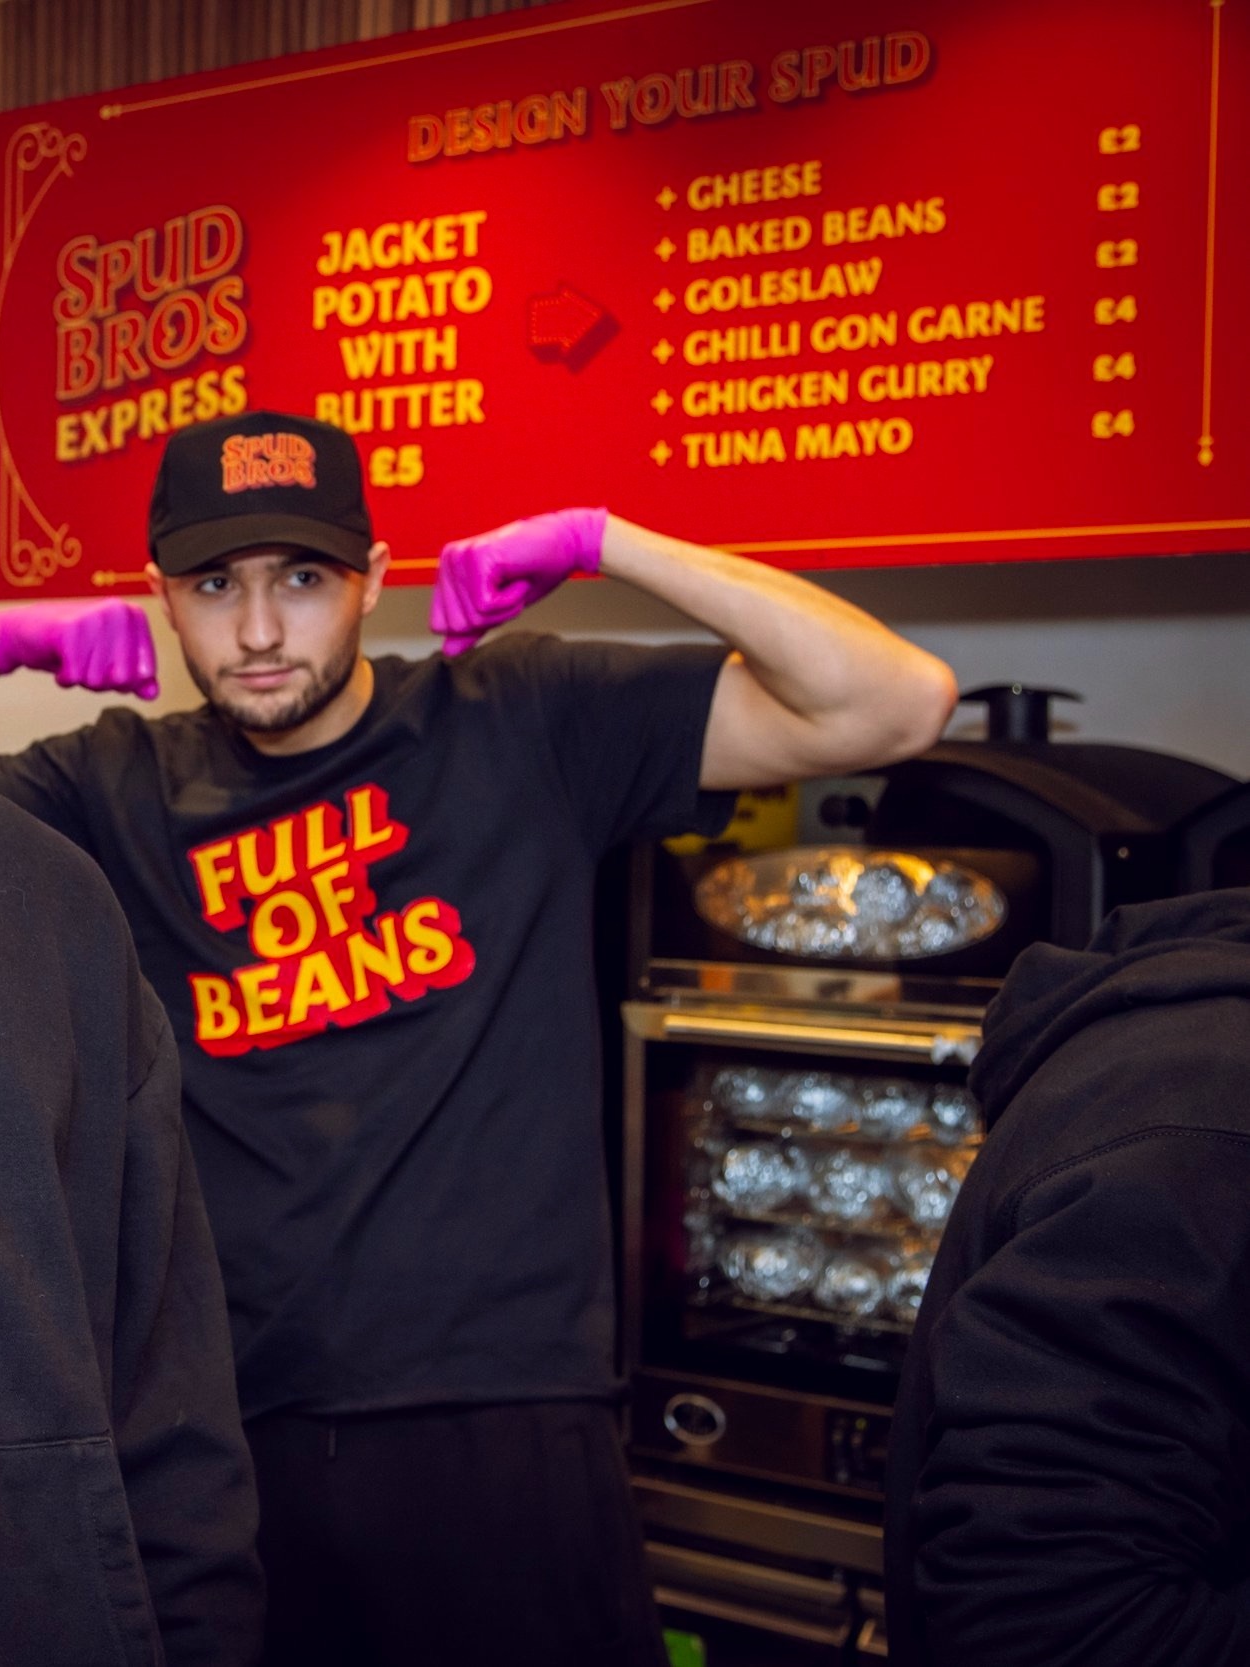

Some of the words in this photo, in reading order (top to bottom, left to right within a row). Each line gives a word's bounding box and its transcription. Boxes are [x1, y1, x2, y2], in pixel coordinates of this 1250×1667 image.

[407, 86, 587, 163] DESIGN
[600, 60, 755, 130] YOUR
[768, 30, 931, 103] SPUD
[686, 160, 823, 211] CHEESE
[316, 210, 488, 276] JACKET
[686, 216, 812, 263] BAKED
[822, 197, 947, 246] BEANS
[54, 204, 245, 326] SPUD
[683, 256, 883, 316] COLESLAW
[312, 266, 493, 330] POTATO
[55, 275, 248, 402] BROS
[338, 325, 458, 381] WITH
[682, 320, 801, 367] CHILLI
[907, 295, 1045, 345] CARNE
[56, 364, 248, 463] EXPRESS
[315, 378, 487, 436] BUTTER
[681, 369, 850, 418] CHICKEN
[857, 355, 994, 403] CURRY
[220, 432, 315, 464] SPUD
[222, 457, 316, 493] BROS
[369, 443, 425, 488] £5
[681, 427, 787, 470] TUNA
[794, 416, 914, 461] MAYO
[190, 786, 400, 920] FULL
[251, 858, 358, 962] OF
[189, 897, 458, 1042] BEANS
